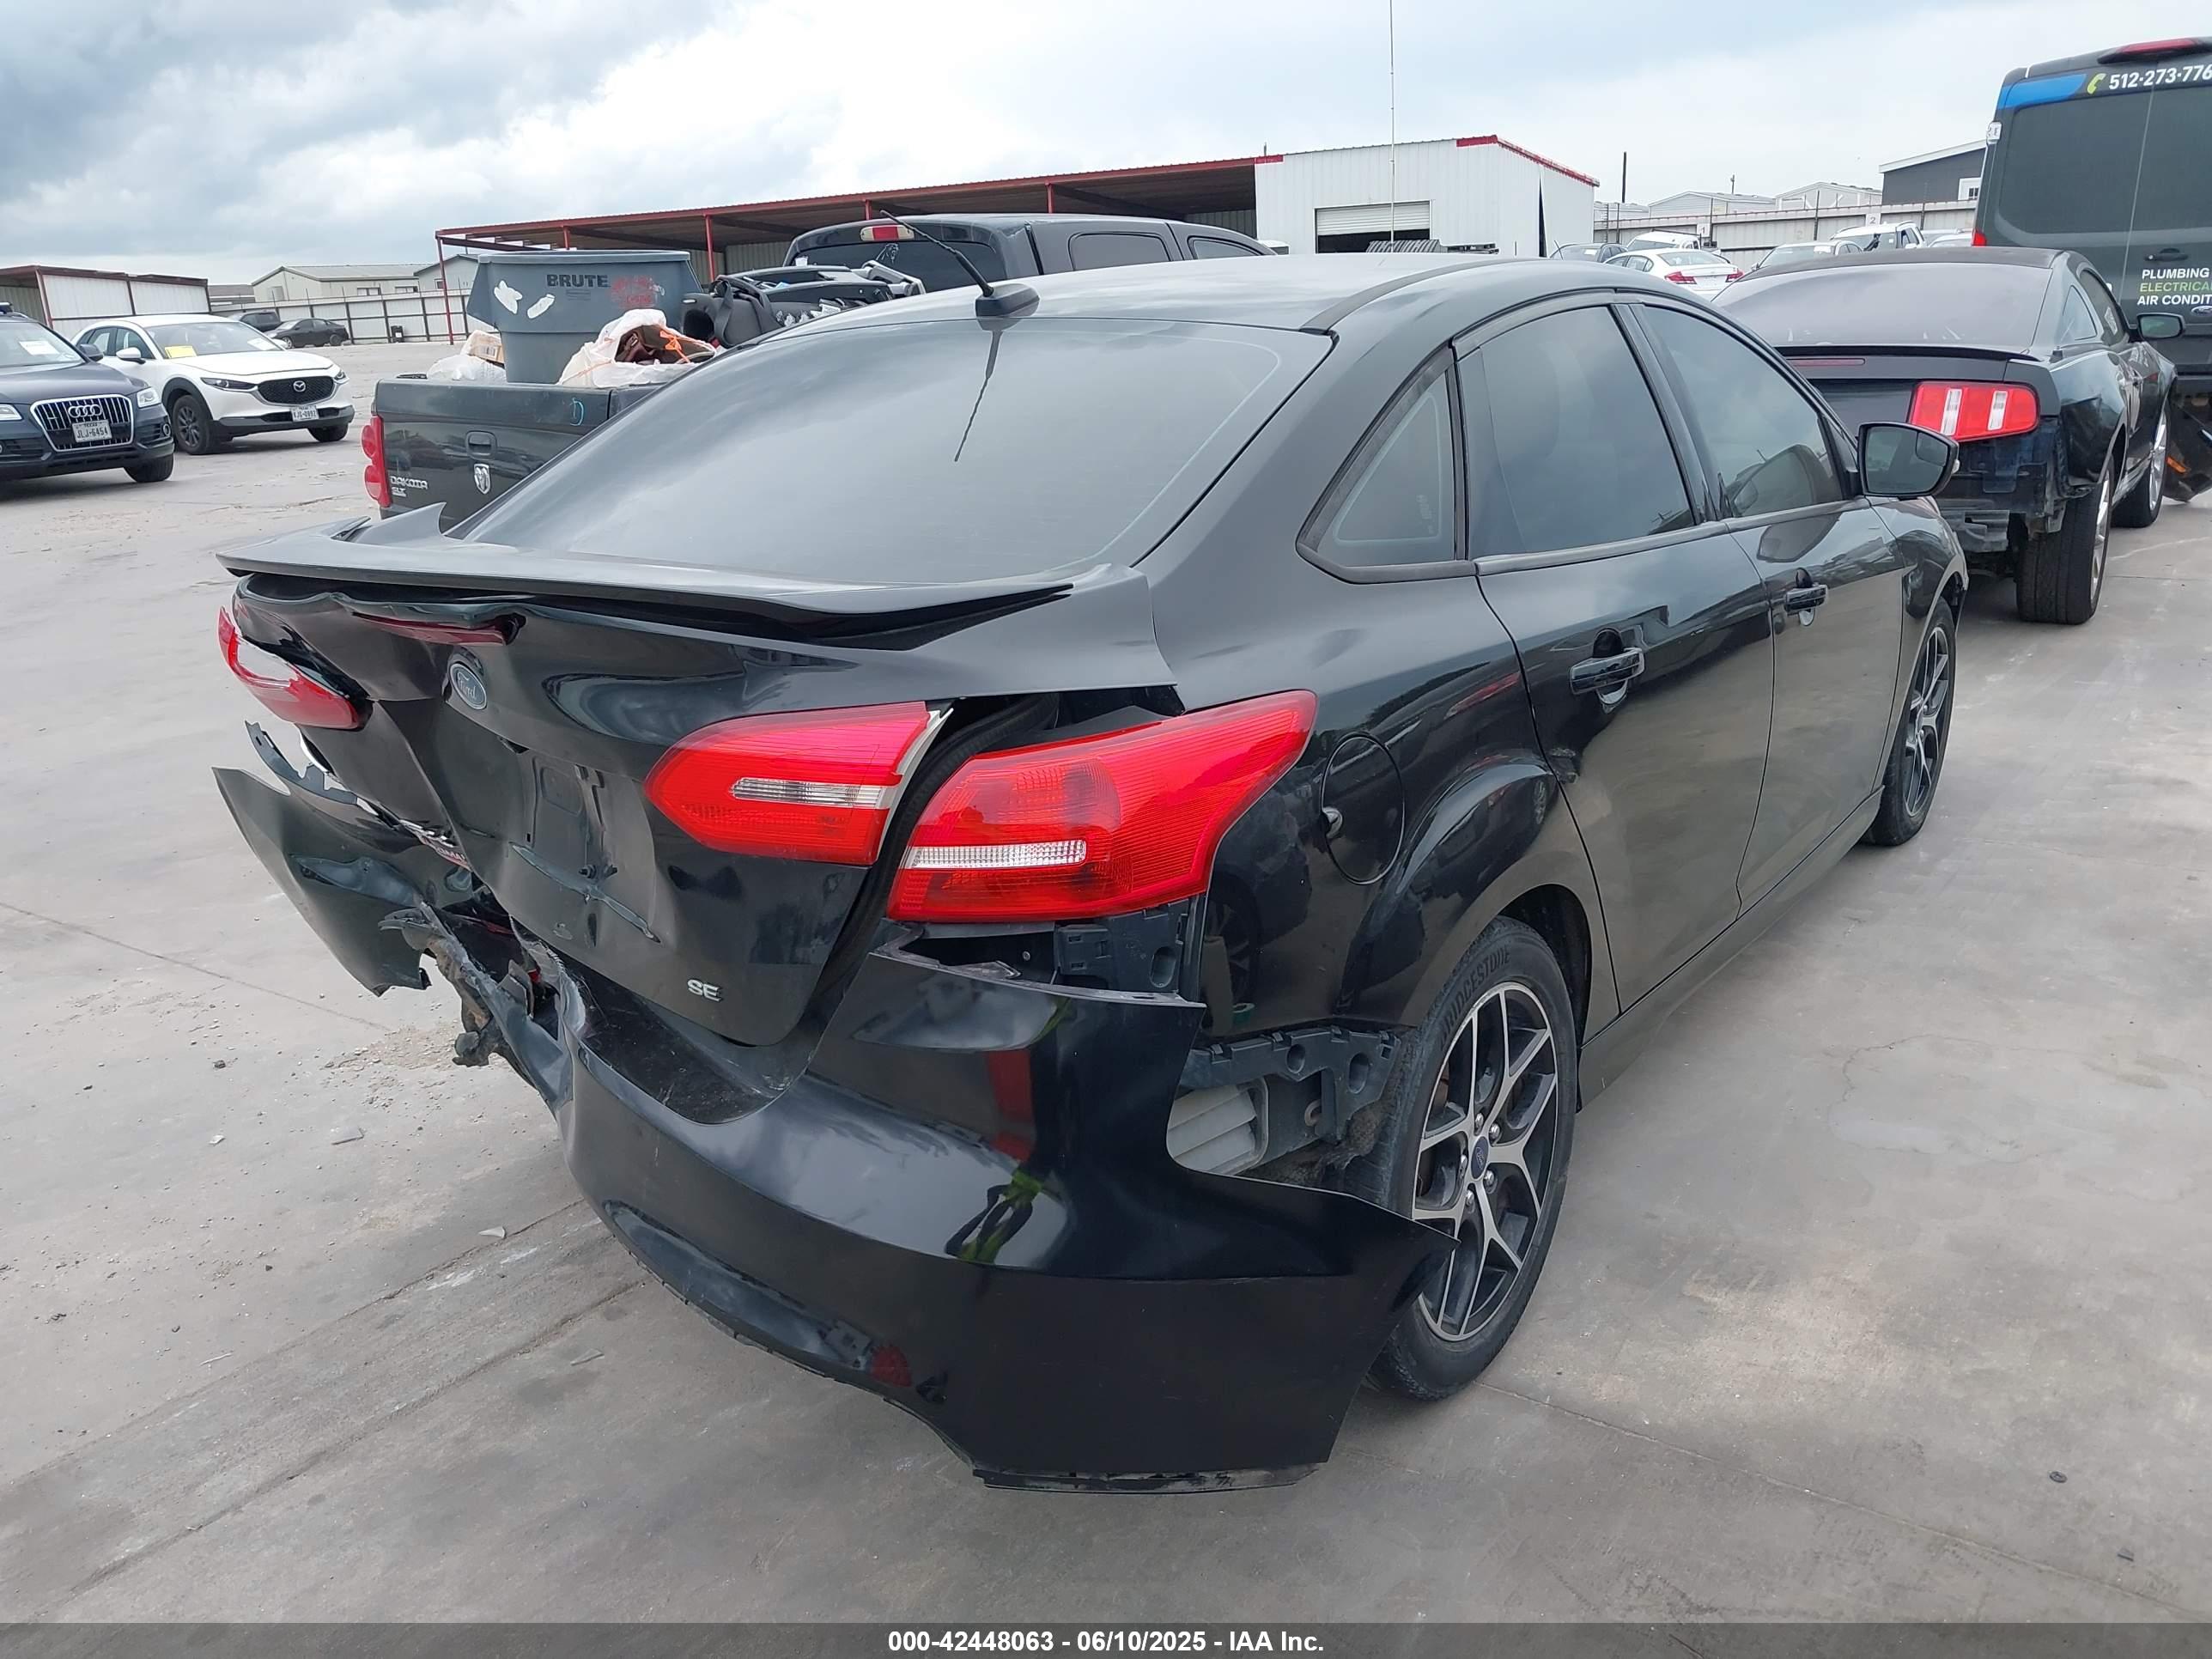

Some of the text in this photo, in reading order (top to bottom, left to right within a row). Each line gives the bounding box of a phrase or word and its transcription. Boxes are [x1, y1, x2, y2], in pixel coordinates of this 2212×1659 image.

[2142, 268, 2210, 279] PLUMBING
[546, 274, 608, 288] BRUTE
[2137, 295, 2212, 305] AIR CONDIT
[687, 979, 721, 1002] SE
